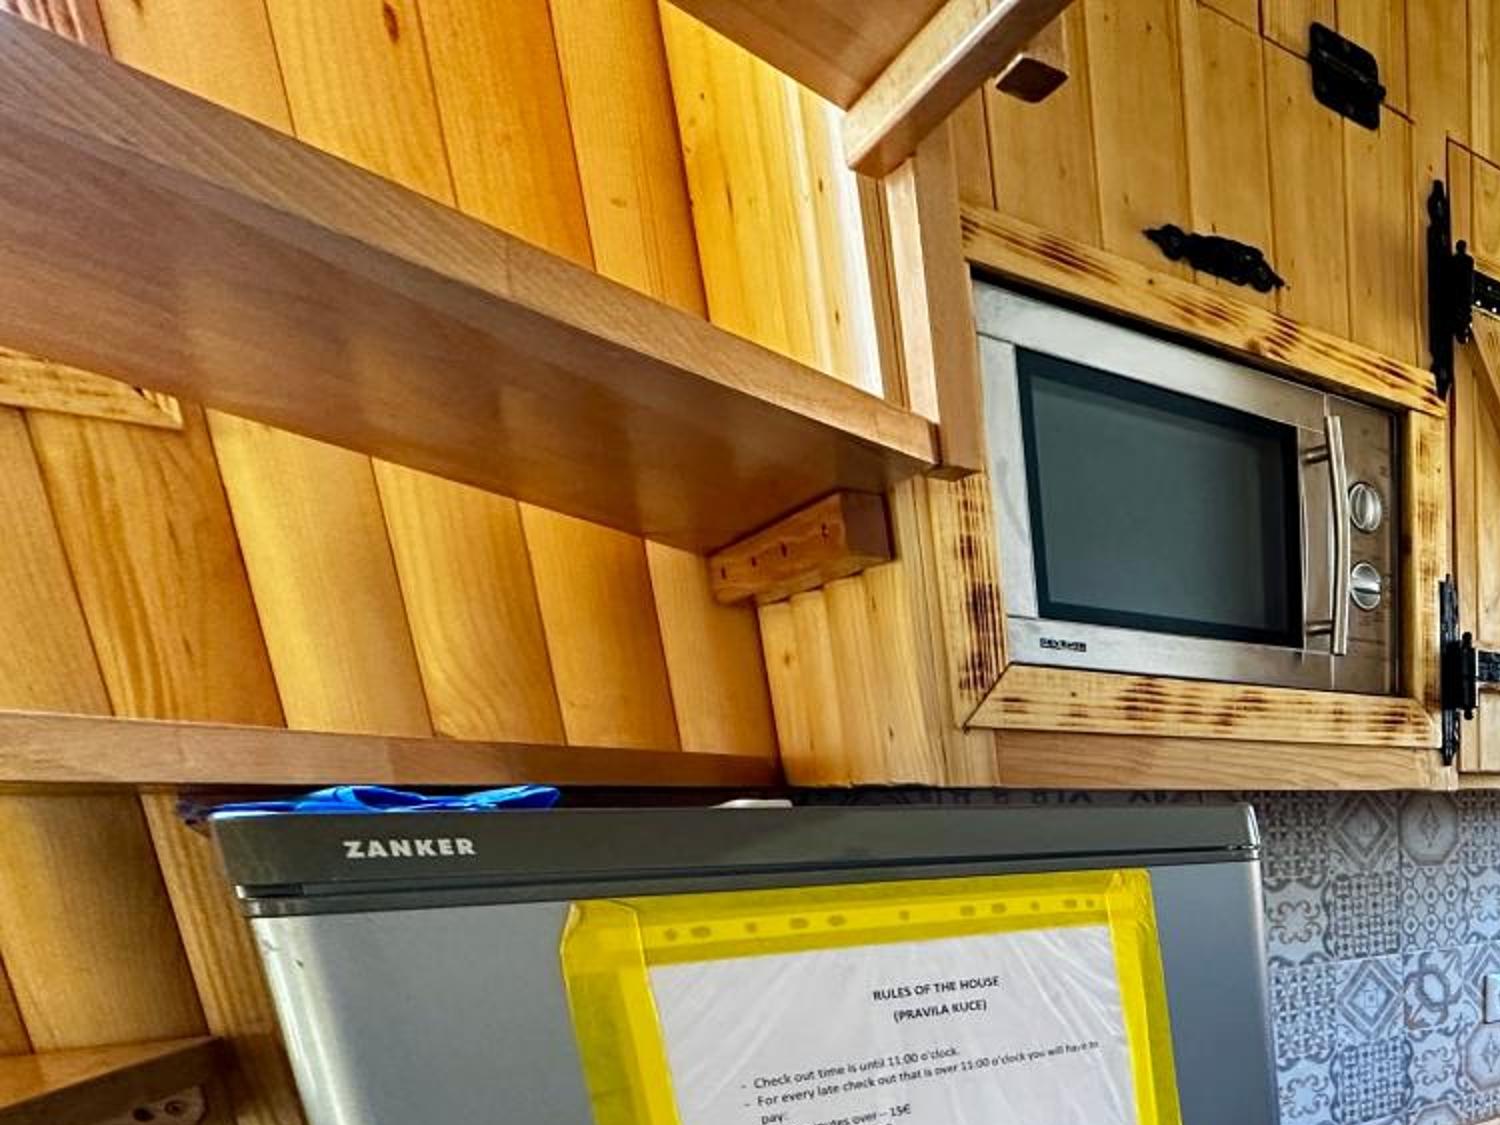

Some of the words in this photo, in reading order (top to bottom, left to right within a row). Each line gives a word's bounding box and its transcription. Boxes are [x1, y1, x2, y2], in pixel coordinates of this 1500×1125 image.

[343, 838, 475, 859] ZANKER
[873, 986, 912, 1001] RULES
[914, 984, 930, 996] OF
[932, 981, 957, 993] THE
[959, 976, 999, 990] HOUSE
[893, 1004, 949, 1023] (PRAVILA
[753, 1072, 792, 1089] Check
[794, 1070, 815, 1083] out
[817, 1066, 846, 1079] time
[847, 1062, 857, 1073] is
[859, 1058, 885, 1071] until
[757, 1094, 777, 1108] For
[781, 1089, 815, 1105] every
[817, 1083, 840, 1097] late
[842, 1077, 875, 1092] check
[877, 1074, 897, 1086] out
[899, 1069, 921, 1082] that
[923, 1067, 933, 1078] is
[934, 1064, 958, 1076] over
[1027, 1050, 1046, 1062] you
[852, 1111, 878, 1125] over
[889, 1103, 912, 1118] 15€
